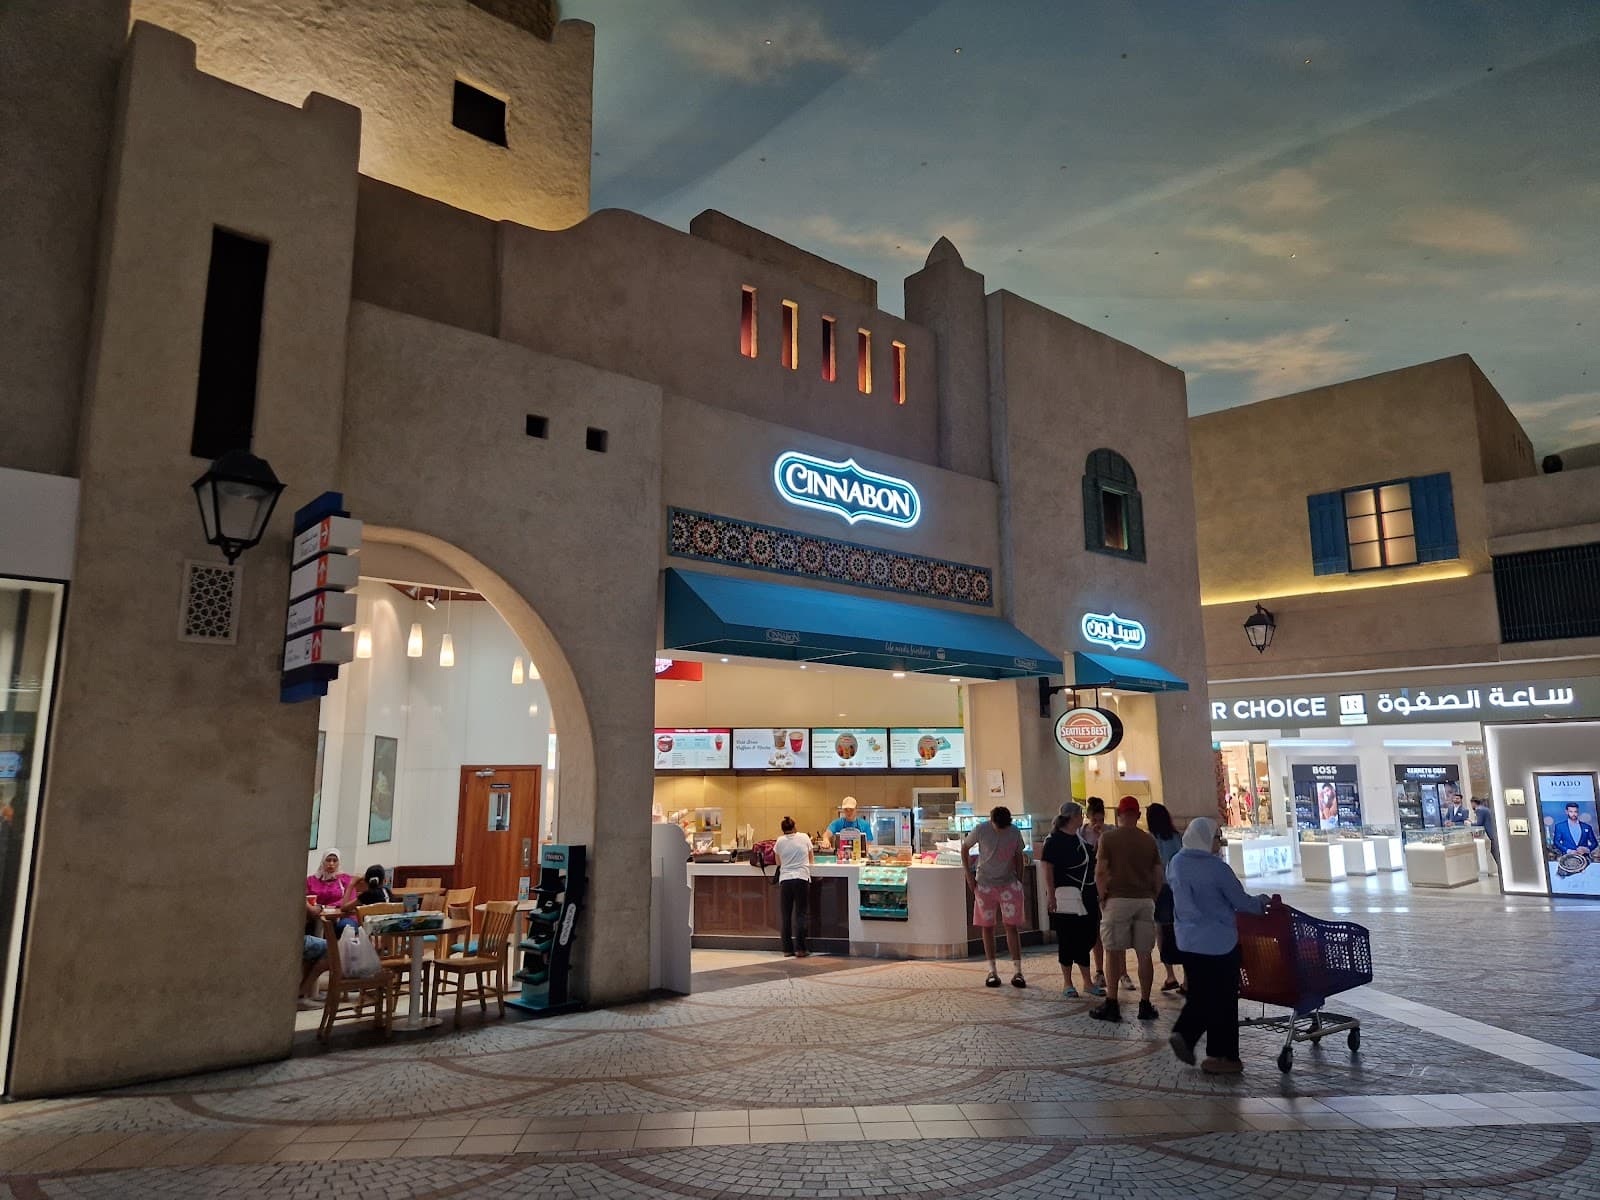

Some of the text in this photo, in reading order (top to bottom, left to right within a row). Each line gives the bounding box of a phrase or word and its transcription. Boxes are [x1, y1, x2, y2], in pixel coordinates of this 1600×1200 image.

[785, 463, 911, 517] CINNABON
[1377, 689, 1481, 716] الصفوة
[1488, 686, 1575, 707] ساعة
[1211, 701, 1228, 720] R
[1233, 697, 1327, 719] CHOICE
[1091, 727, 1108, 736] BEST
[1312, 766, 1337, 774] BOSS
